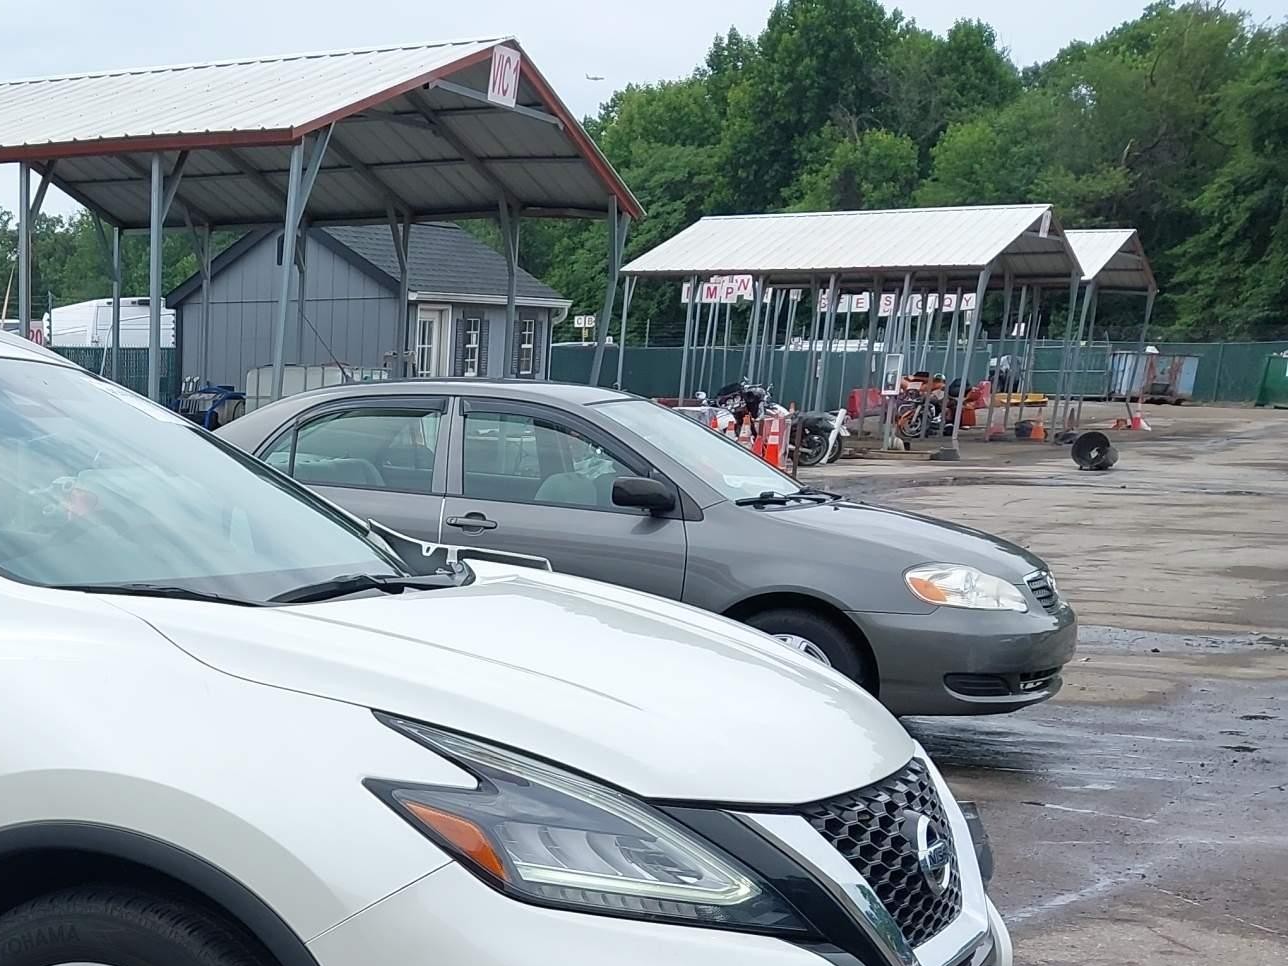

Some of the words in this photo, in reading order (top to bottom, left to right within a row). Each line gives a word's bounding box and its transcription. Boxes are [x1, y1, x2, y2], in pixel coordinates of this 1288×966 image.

[492, 52, 512, 97] VIC
[512, 59, 520, 100] 1
[705, 286, 718, 300] M
[725, 286, 734, 300] P
[856, 297, 865, 309] E
[884, 295, 892, 307] S
[963, 296, 972, 307] Y
